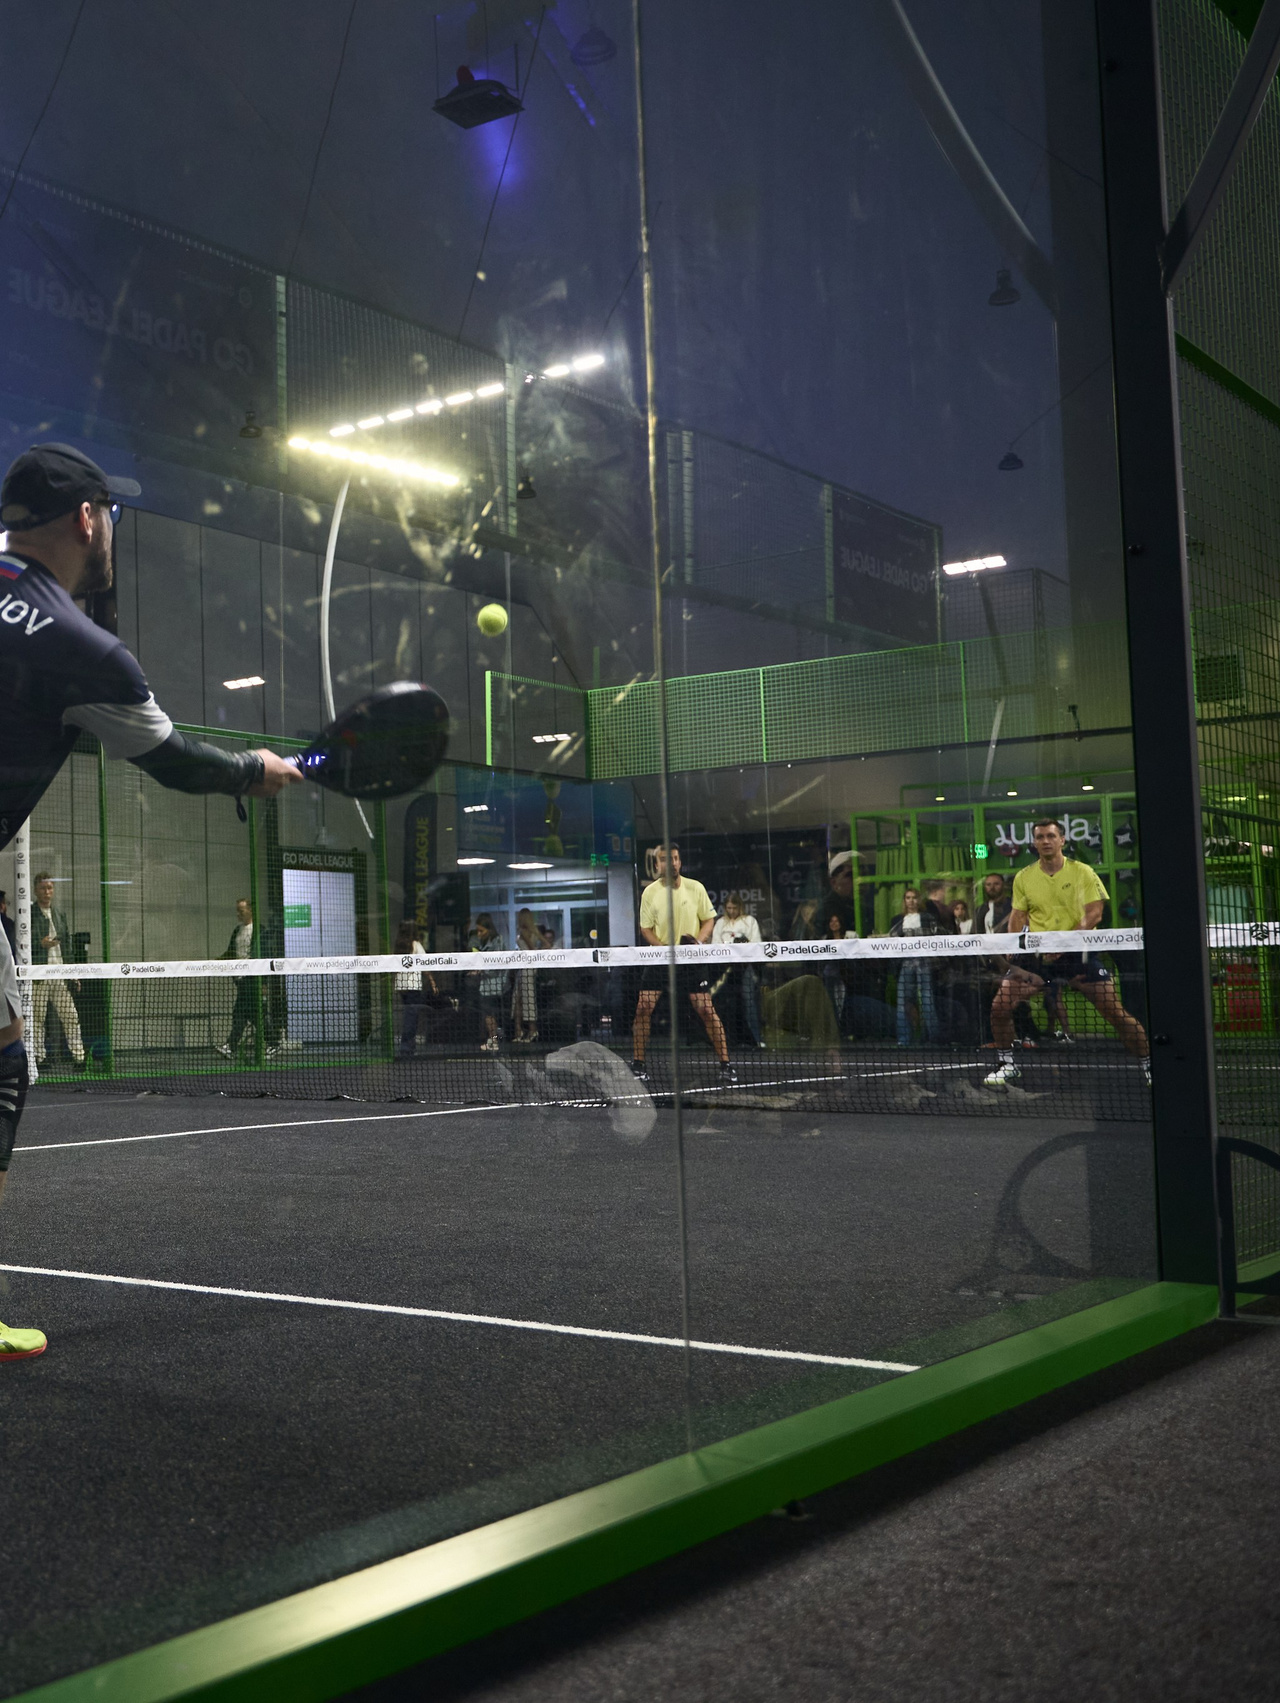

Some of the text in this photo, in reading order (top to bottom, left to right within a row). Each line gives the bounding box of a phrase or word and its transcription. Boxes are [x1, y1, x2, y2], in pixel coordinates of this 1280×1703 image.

[415, 816, 429, 876] LEAGUE
[483, 952, 566, 965] www.padelgalis.com
[781, 944, 837, 955] PadelGalis
[871, 938, 982, 952] www.padelgalis.com
